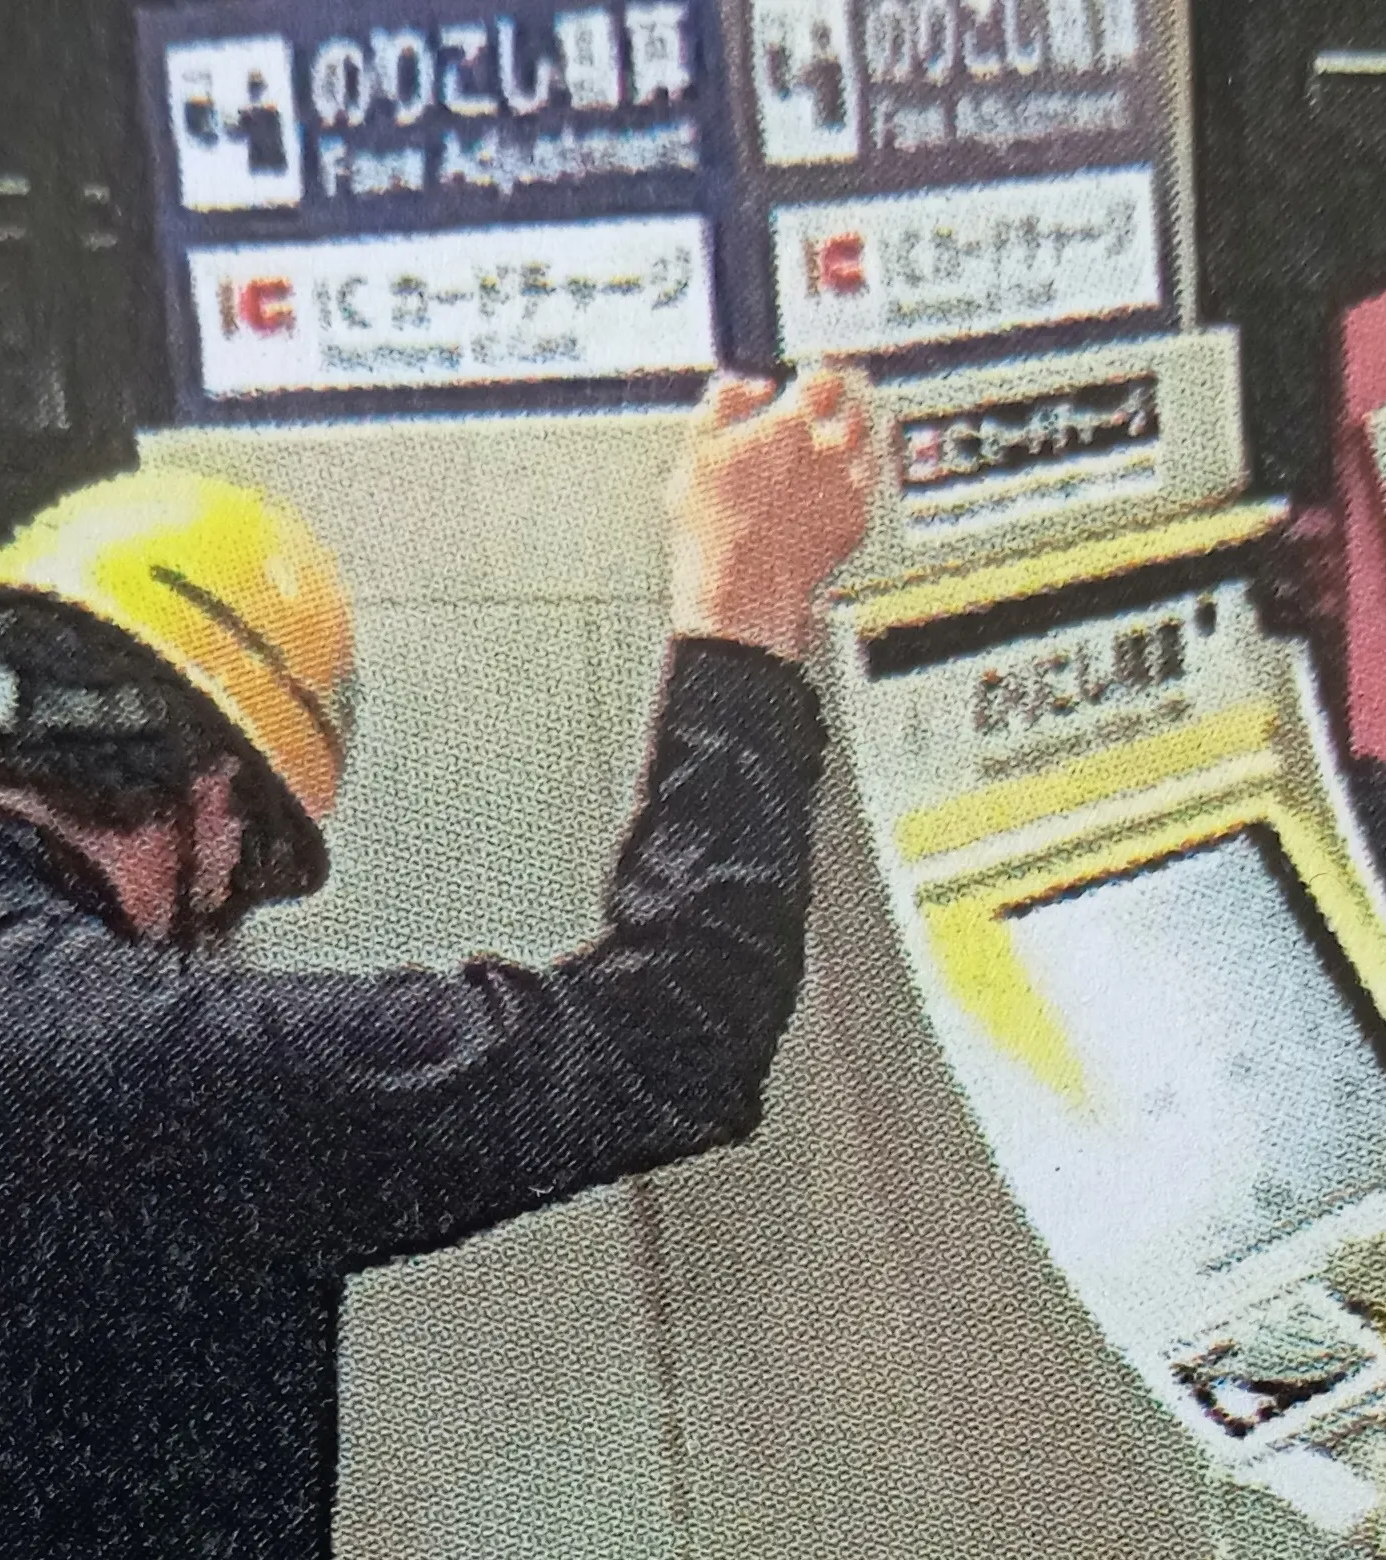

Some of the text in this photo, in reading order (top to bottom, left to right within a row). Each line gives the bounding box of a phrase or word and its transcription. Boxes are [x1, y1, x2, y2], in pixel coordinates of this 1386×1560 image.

[314, 2, 693, 127] のりこし精算
[319, 120, 700, 197] Fare Adjustment
